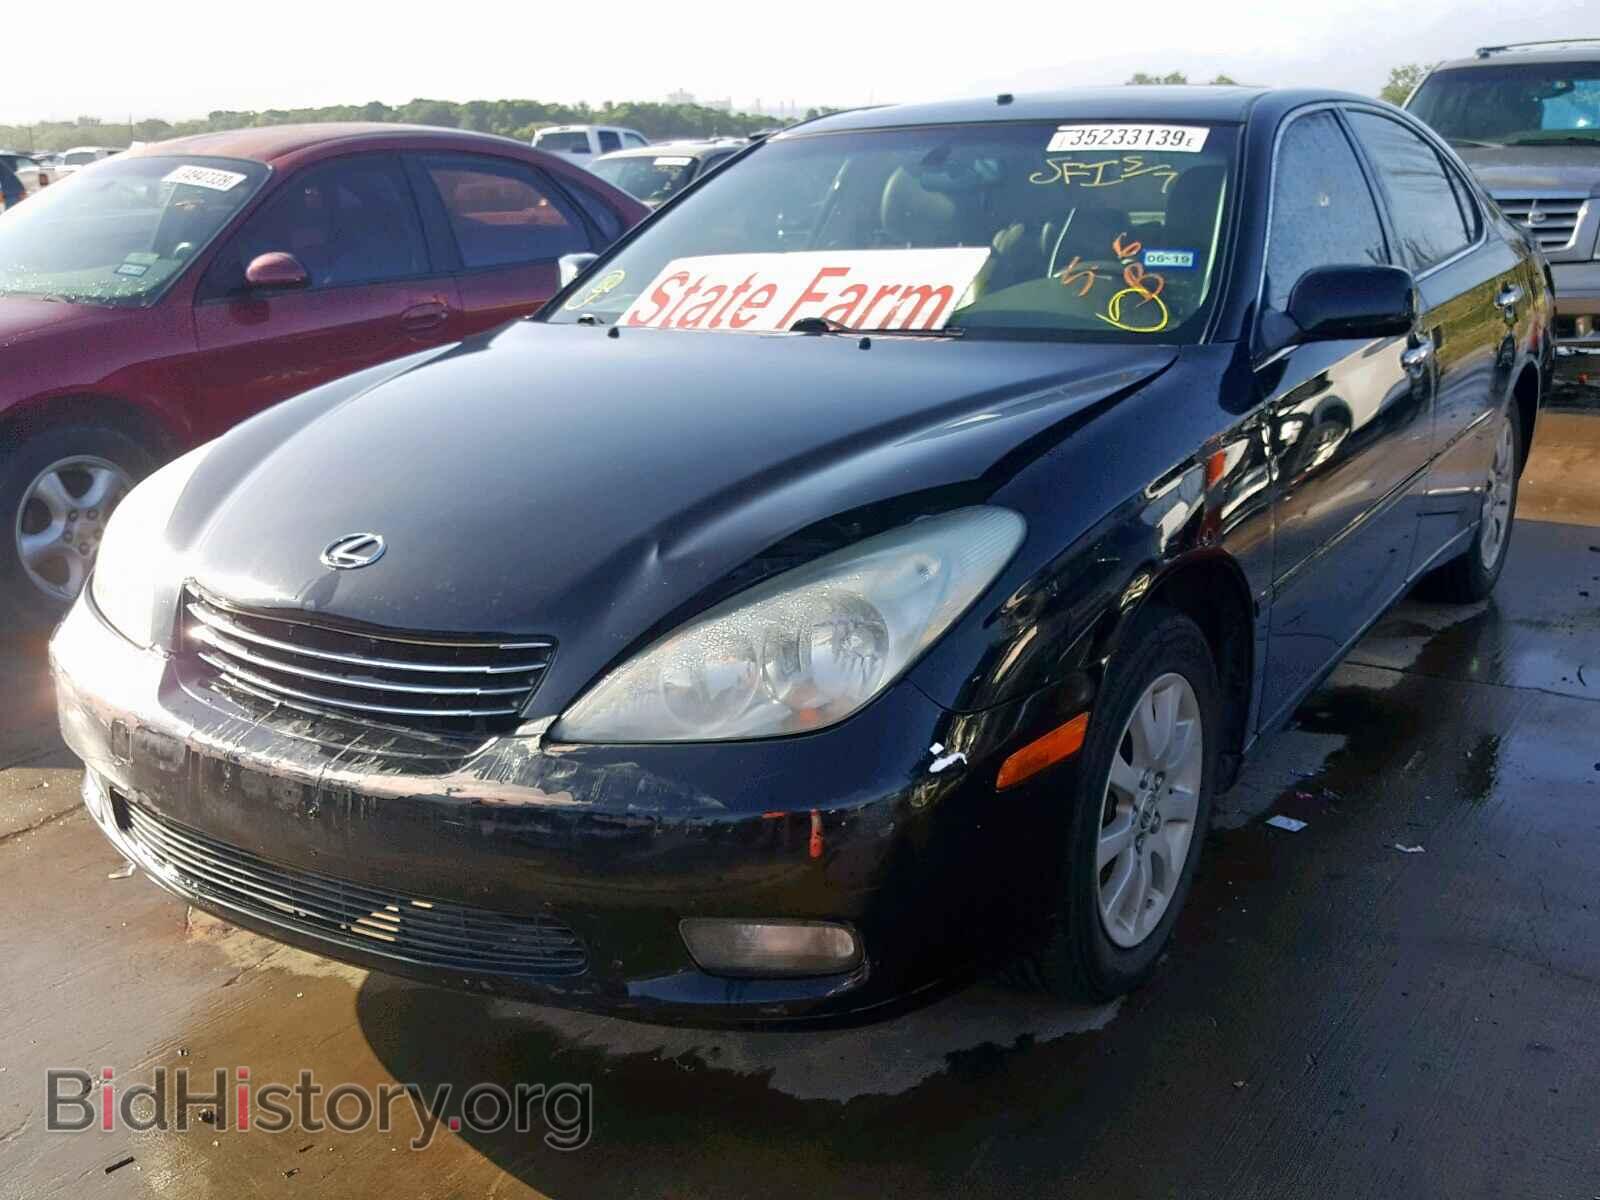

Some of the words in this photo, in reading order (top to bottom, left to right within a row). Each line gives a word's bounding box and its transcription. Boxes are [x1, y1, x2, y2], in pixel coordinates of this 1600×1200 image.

[1069, 128, 1187, 147] 35233139
[626, 270, 779, 329] State
[774, 266, 955, 330] Farm
